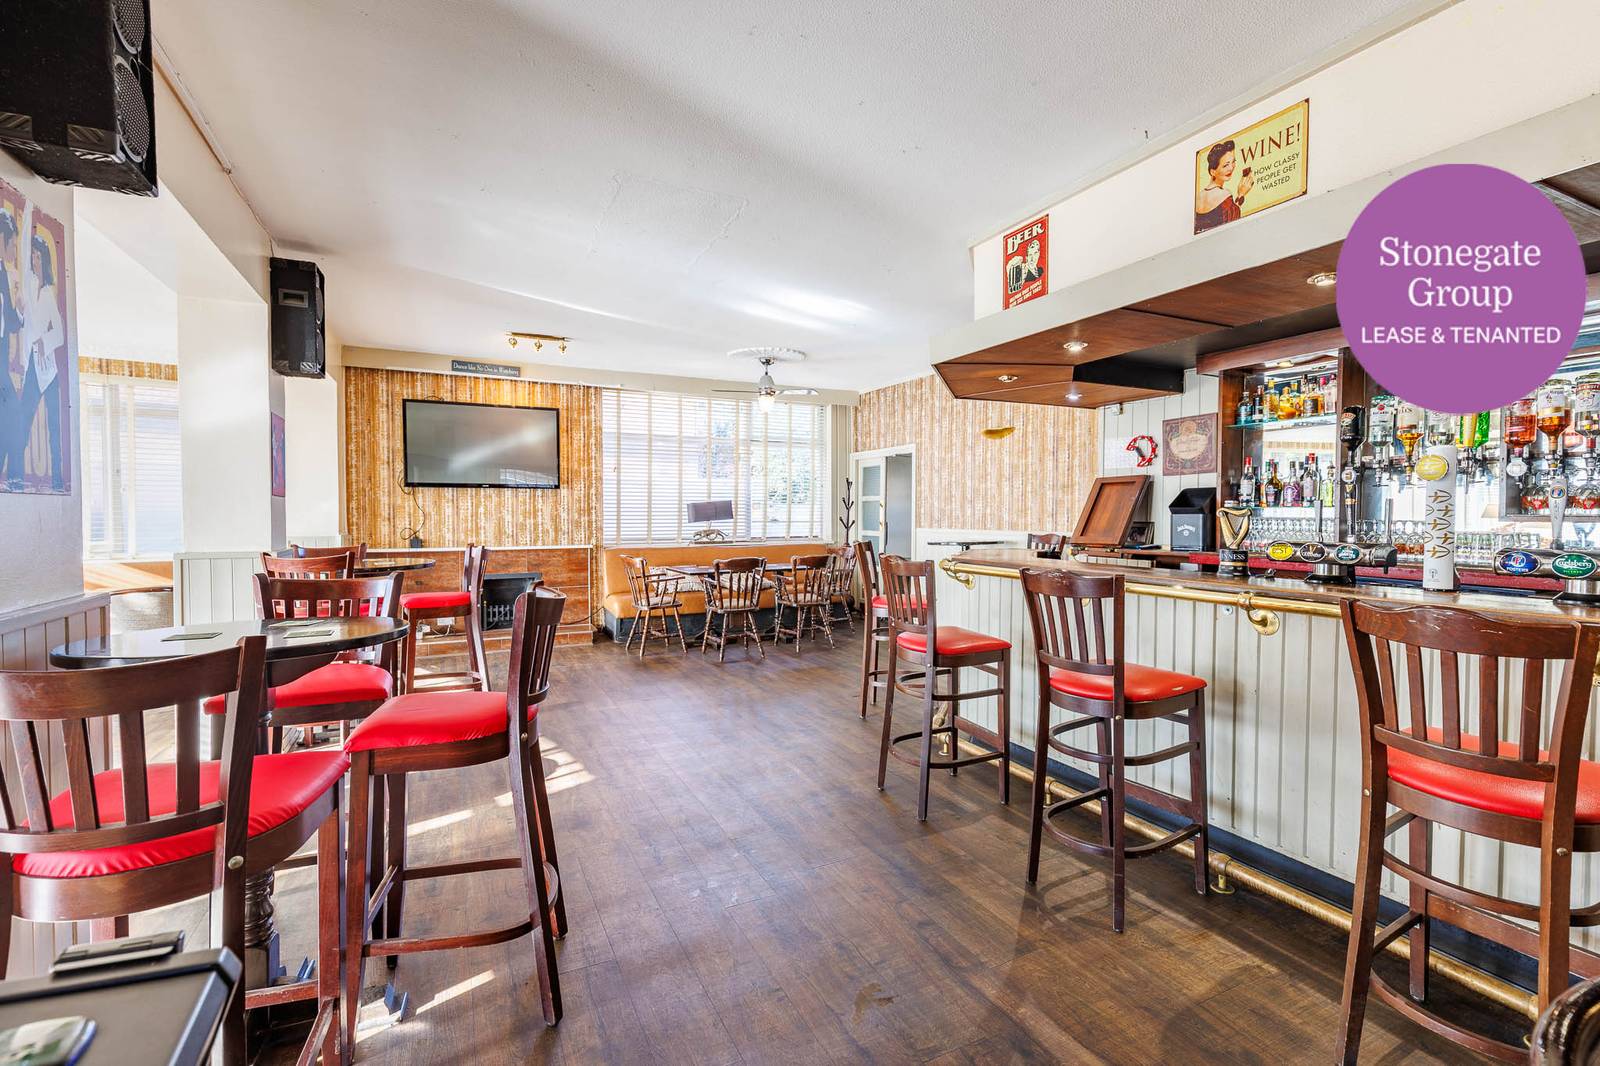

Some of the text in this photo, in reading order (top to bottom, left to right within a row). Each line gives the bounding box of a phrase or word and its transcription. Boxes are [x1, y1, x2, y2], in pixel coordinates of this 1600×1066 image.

[1241, 122, 1301, 164] WINE!
[1253, 152, 1300, 176] HOW CLASSY
[1256, 163, 1297, 185] PEOPLE GET
[1261, 175, 1291, 190] WASTED
[1007, 223, 1045, 255] BEER
[1556, 557, 1592, 570] Carlsberg
